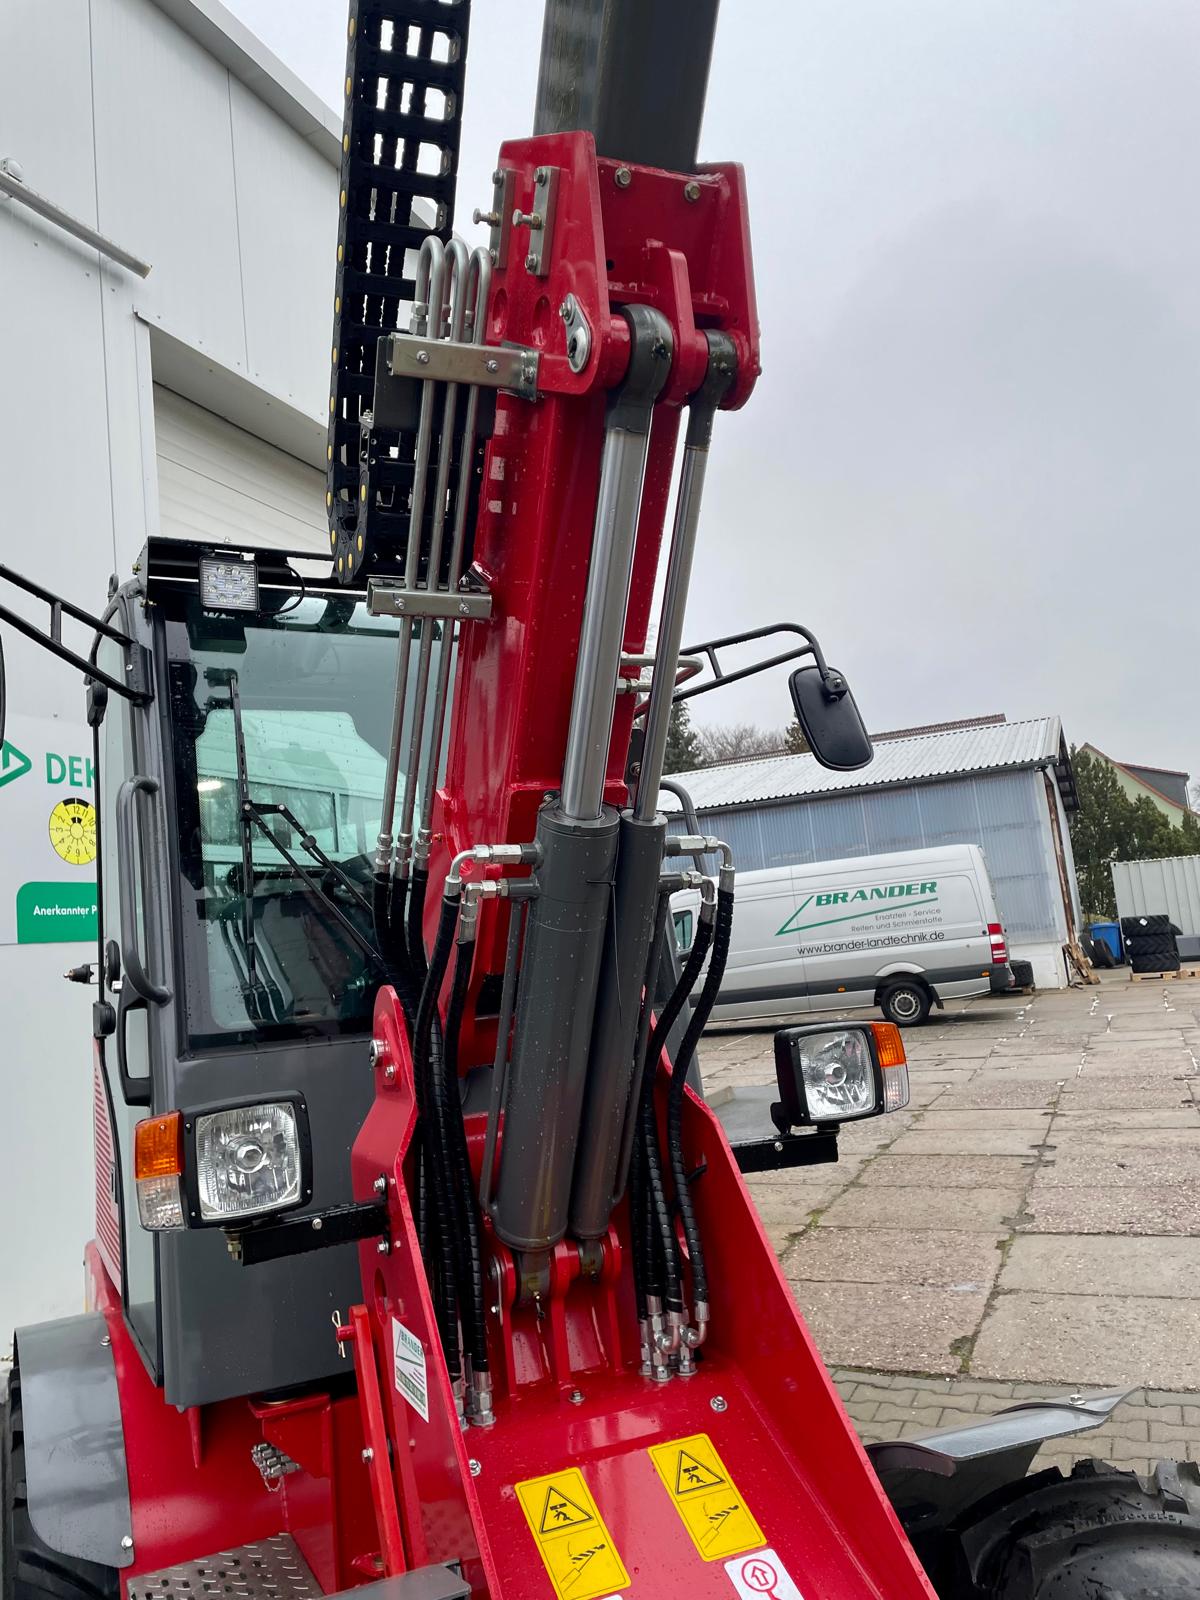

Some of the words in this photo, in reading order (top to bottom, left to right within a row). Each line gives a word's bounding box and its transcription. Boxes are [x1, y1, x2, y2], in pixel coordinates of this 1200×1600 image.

[815, 881, 937, 907] BRANDER
[33, 903, 90, 916] Anerkannter
[874, 911, 907, 921] Ersatzteil
[913, 908, 942, 917] Service
[876, 921, 891, 930] und
[797, 931, 945, 955] www.brander-landtechnik.de
